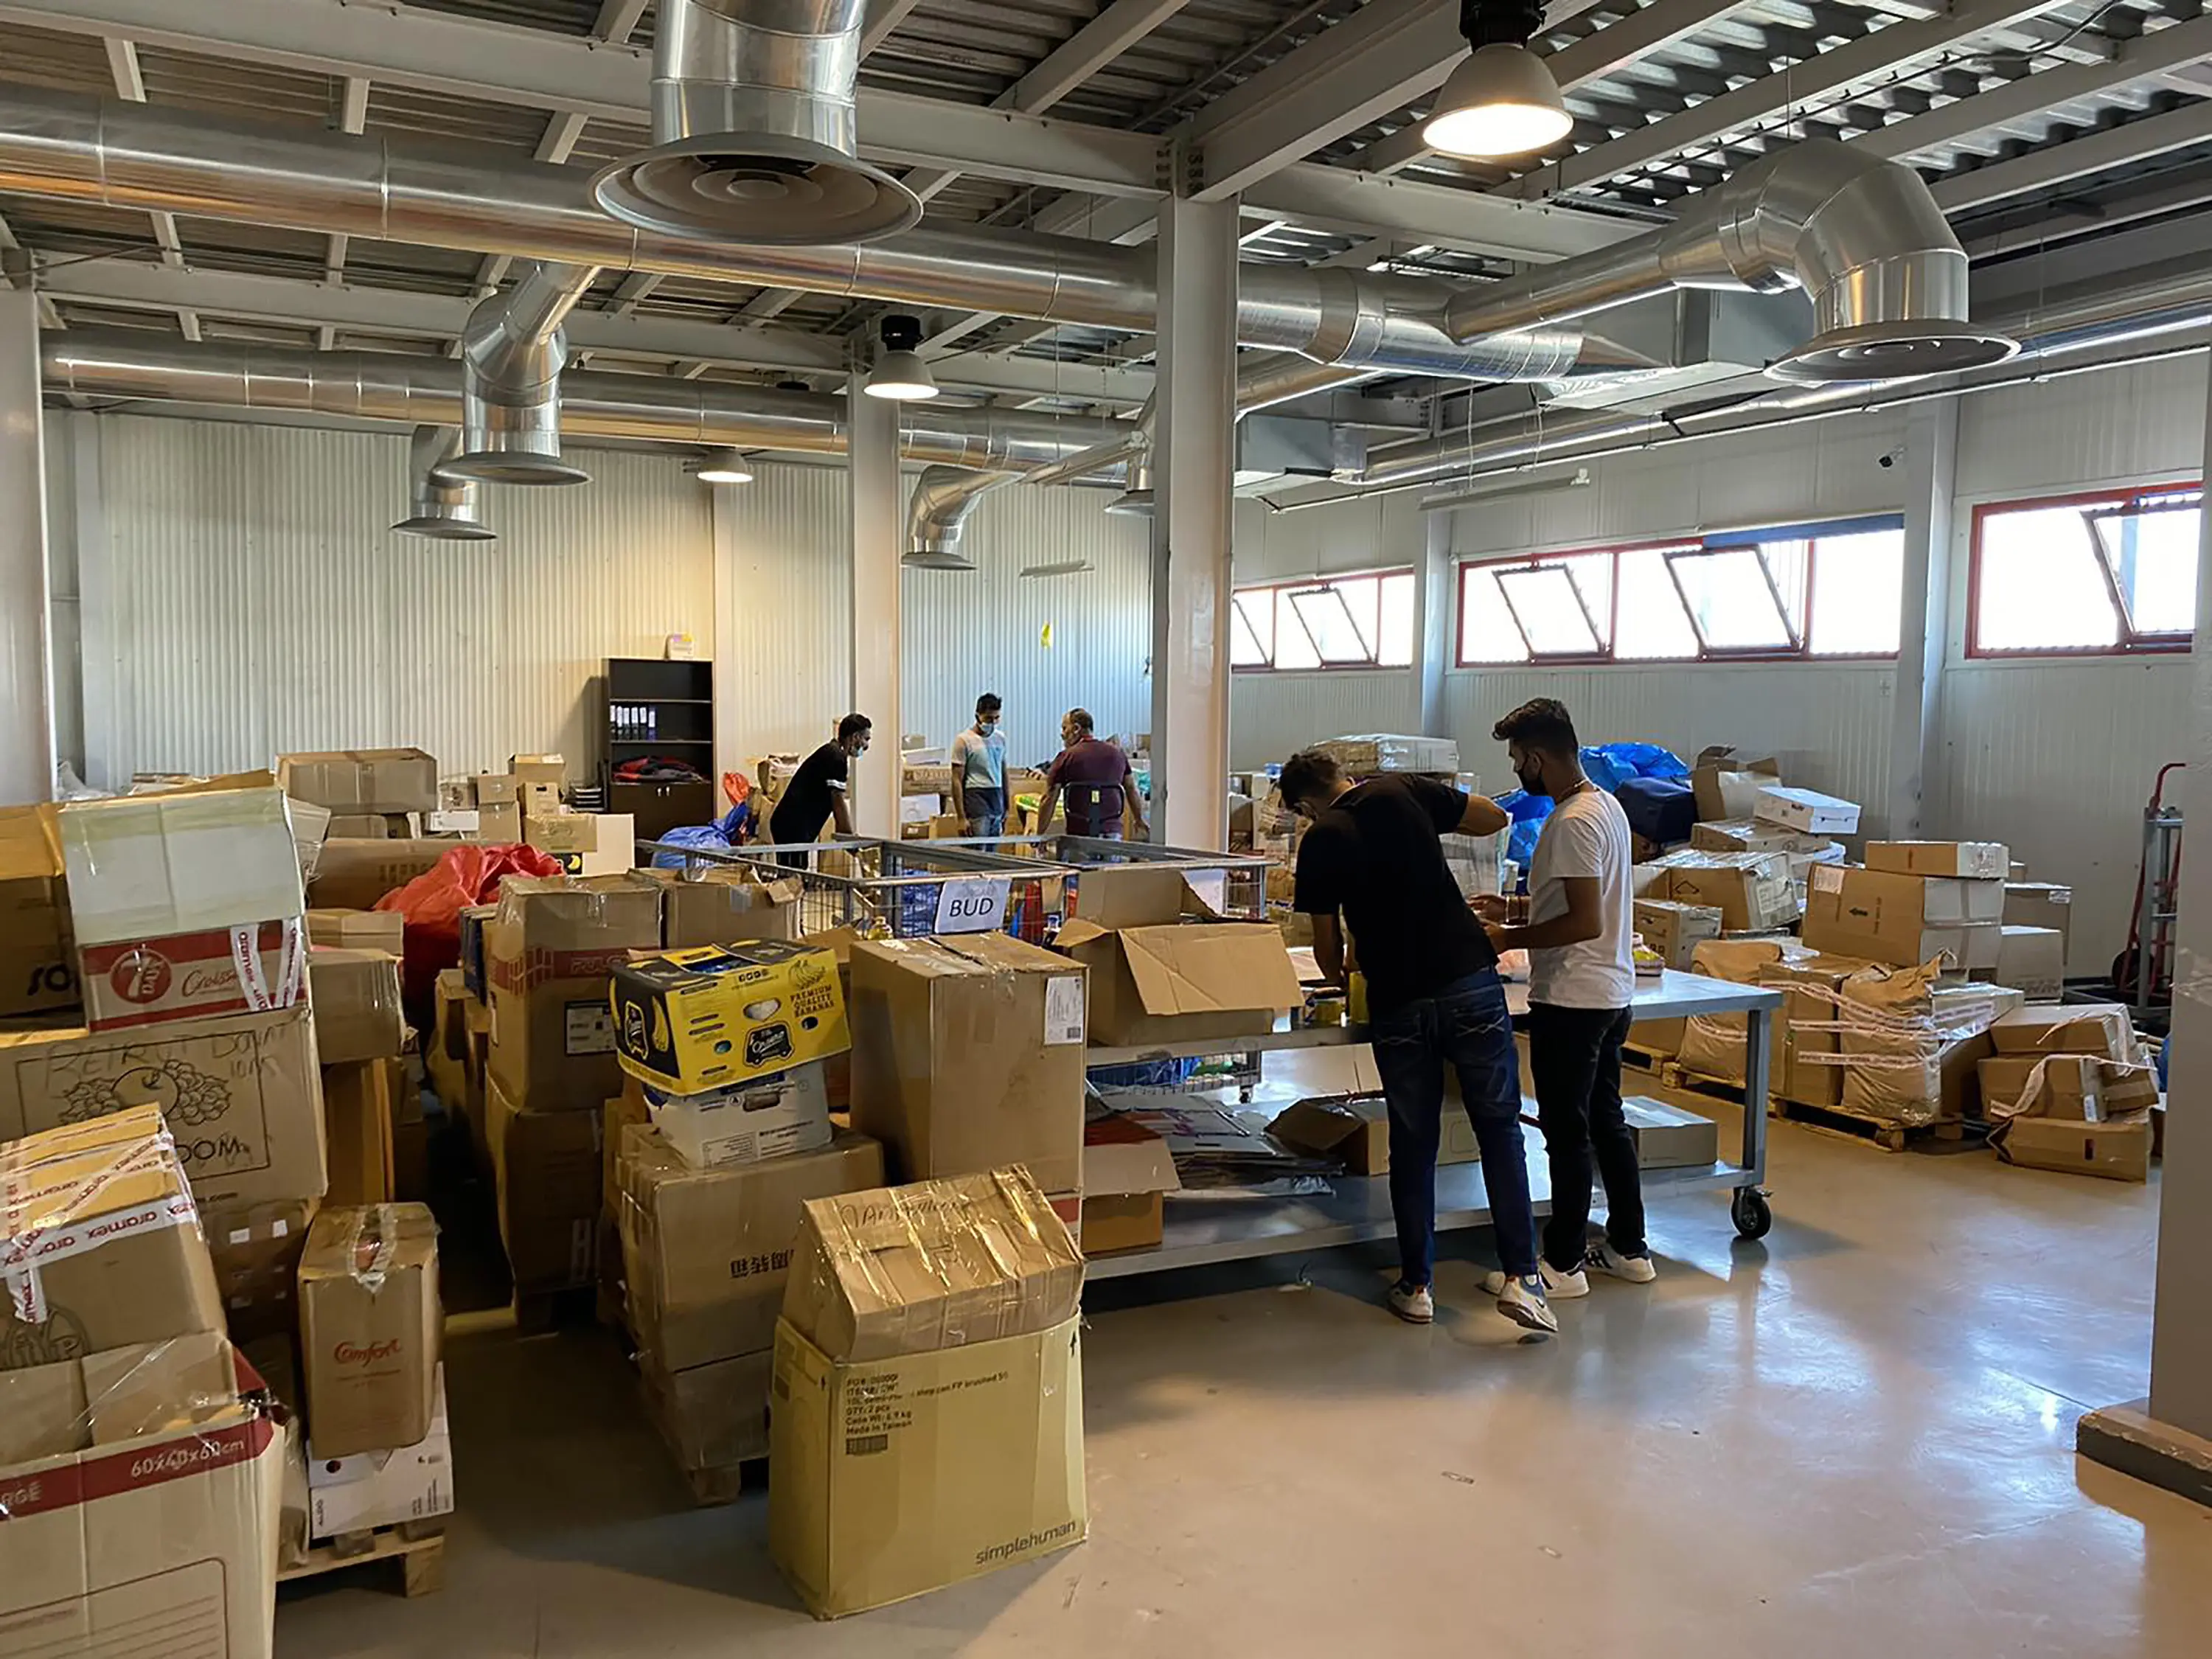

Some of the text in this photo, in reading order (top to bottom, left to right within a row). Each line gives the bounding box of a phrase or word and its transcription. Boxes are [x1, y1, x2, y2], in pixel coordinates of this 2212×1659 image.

[950, 897, 994, 917] BUD
[794, 993, 832, 1009] QUALITY
[176, 1139, 241, 1165] OOM
[88, 1211, 157, 1239] aramex
[334, 1338, 403, 1368] Comfort
[883, 1420, 913, 1432] Taiwan
[975, 1520, 1077, 1565] simplehuman
